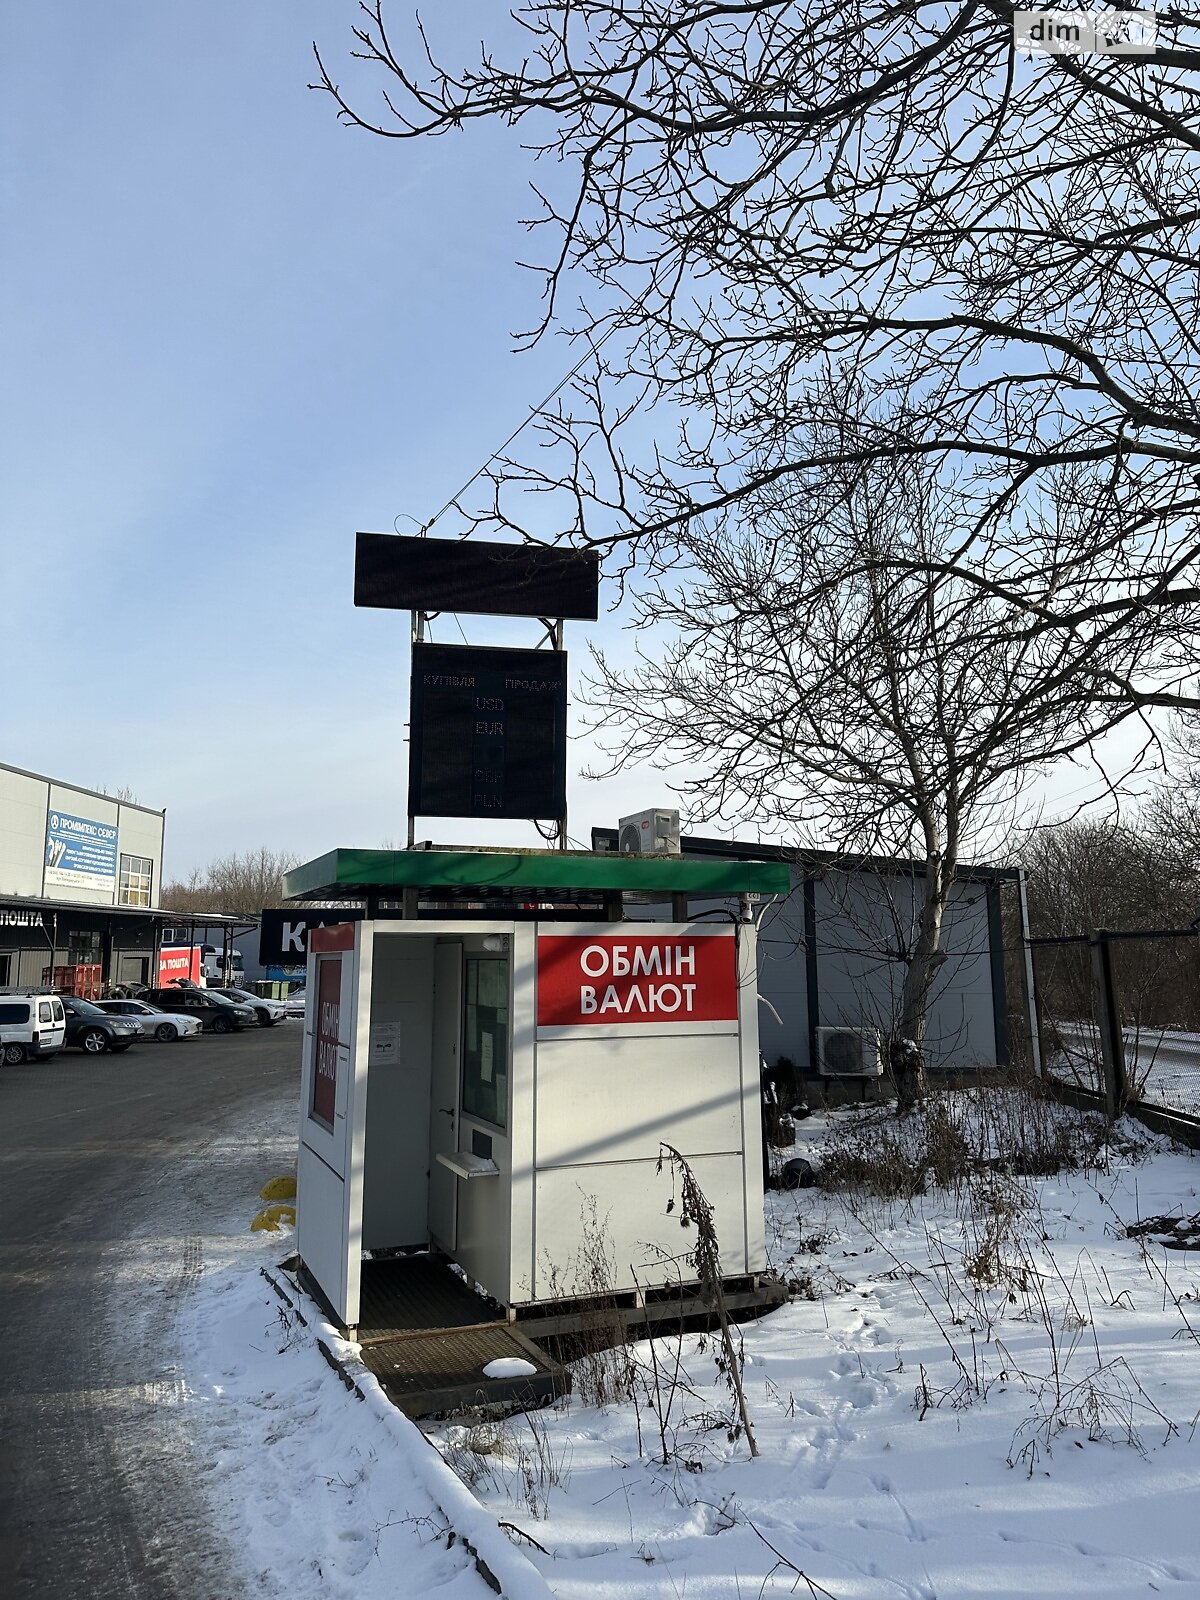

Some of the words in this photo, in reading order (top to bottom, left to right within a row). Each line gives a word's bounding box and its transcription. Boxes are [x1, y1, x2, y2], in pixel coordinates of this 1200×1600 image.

[423, 675, 475, 687] КУПІВЛЯ
[505, 679, 561, 691] ПРОДАЖ
[476, 697, 504, 711] USD
[476, 721, 504, 735] EUR
[0, 910, 43, 927] ПОШТА
[167, 957, 189, 970] ПОШТА
[580, 945, 696, 978] ОБМІН
[580, 983, 697, 1015] ВАЛЮТ
